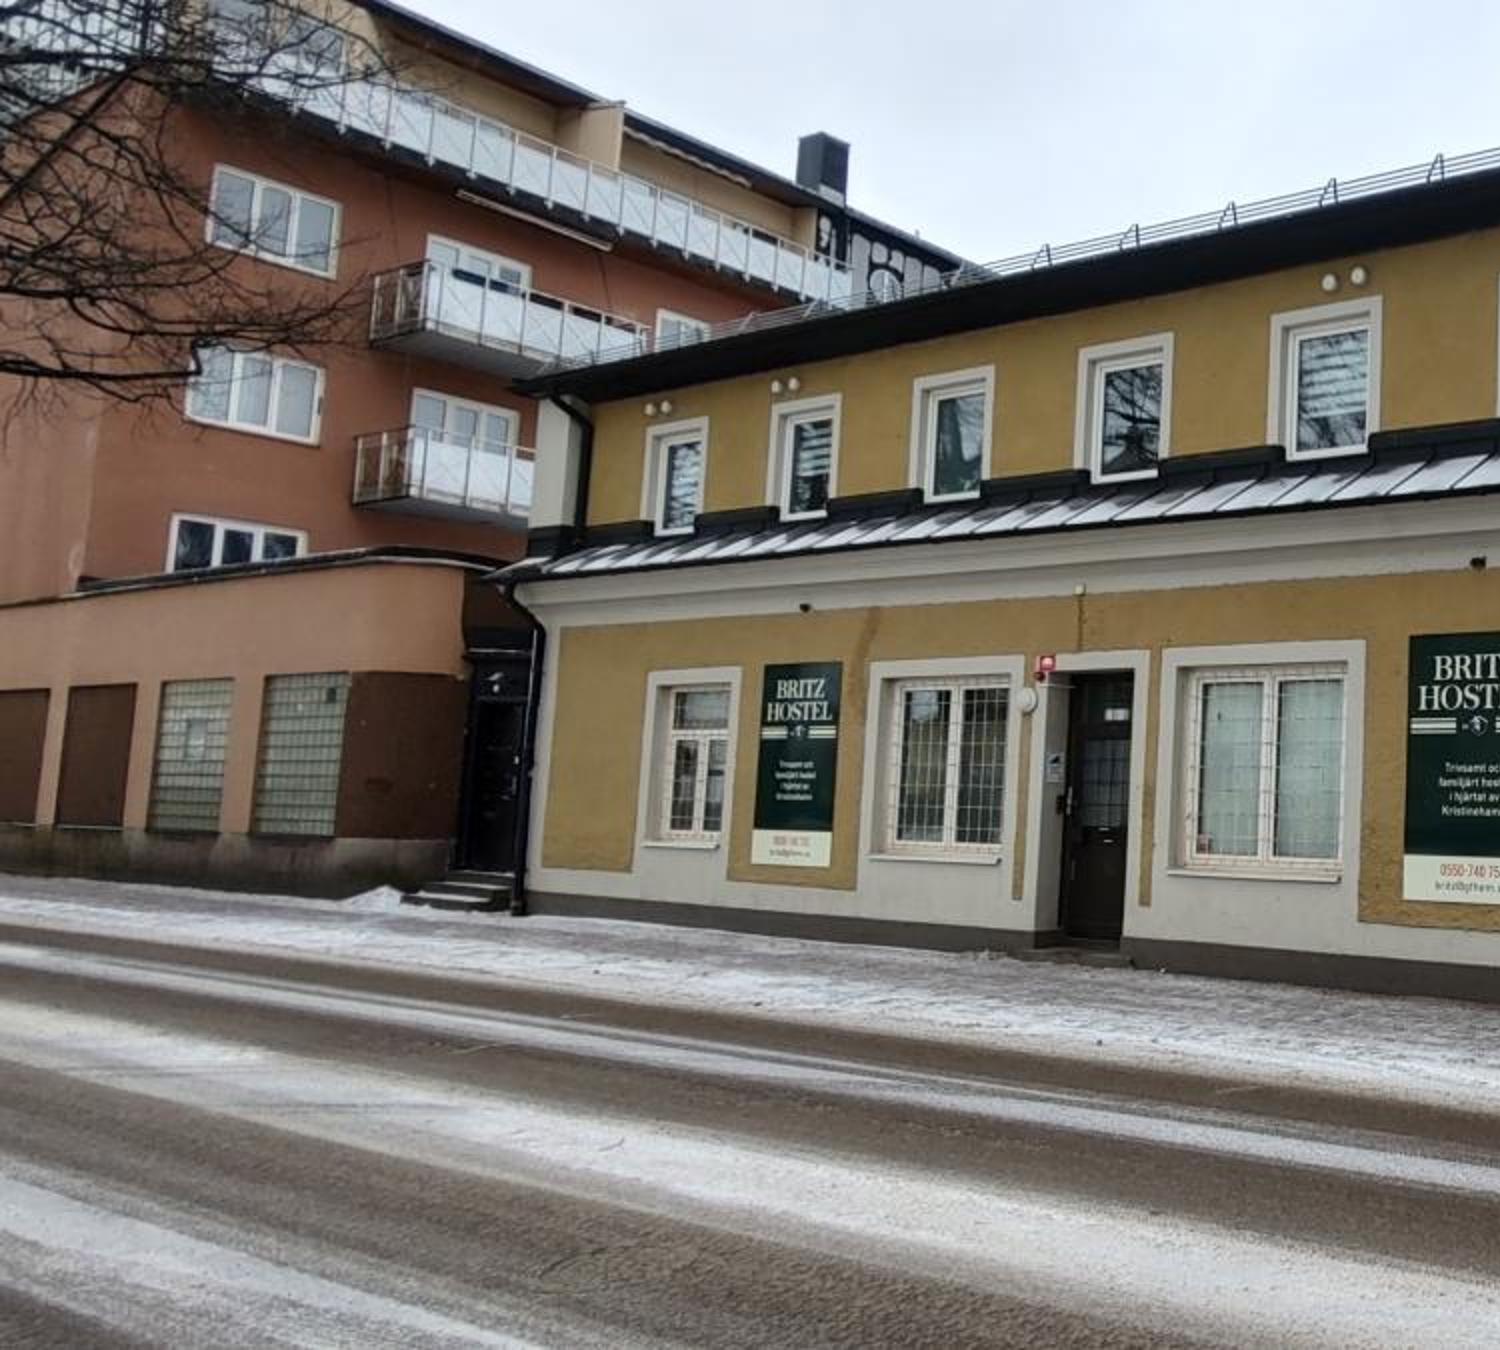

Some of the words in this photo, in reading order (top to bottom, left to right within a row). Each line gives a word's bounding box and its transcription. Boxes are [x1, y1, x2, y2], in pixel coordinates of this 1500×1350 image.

[776, 678, 825, 699] BRITZ
[767, 701, 833, 721] HOSTEL
[1488, 794, 1500, 802] av
[1440, 863, 1485, 878] 0550-740
